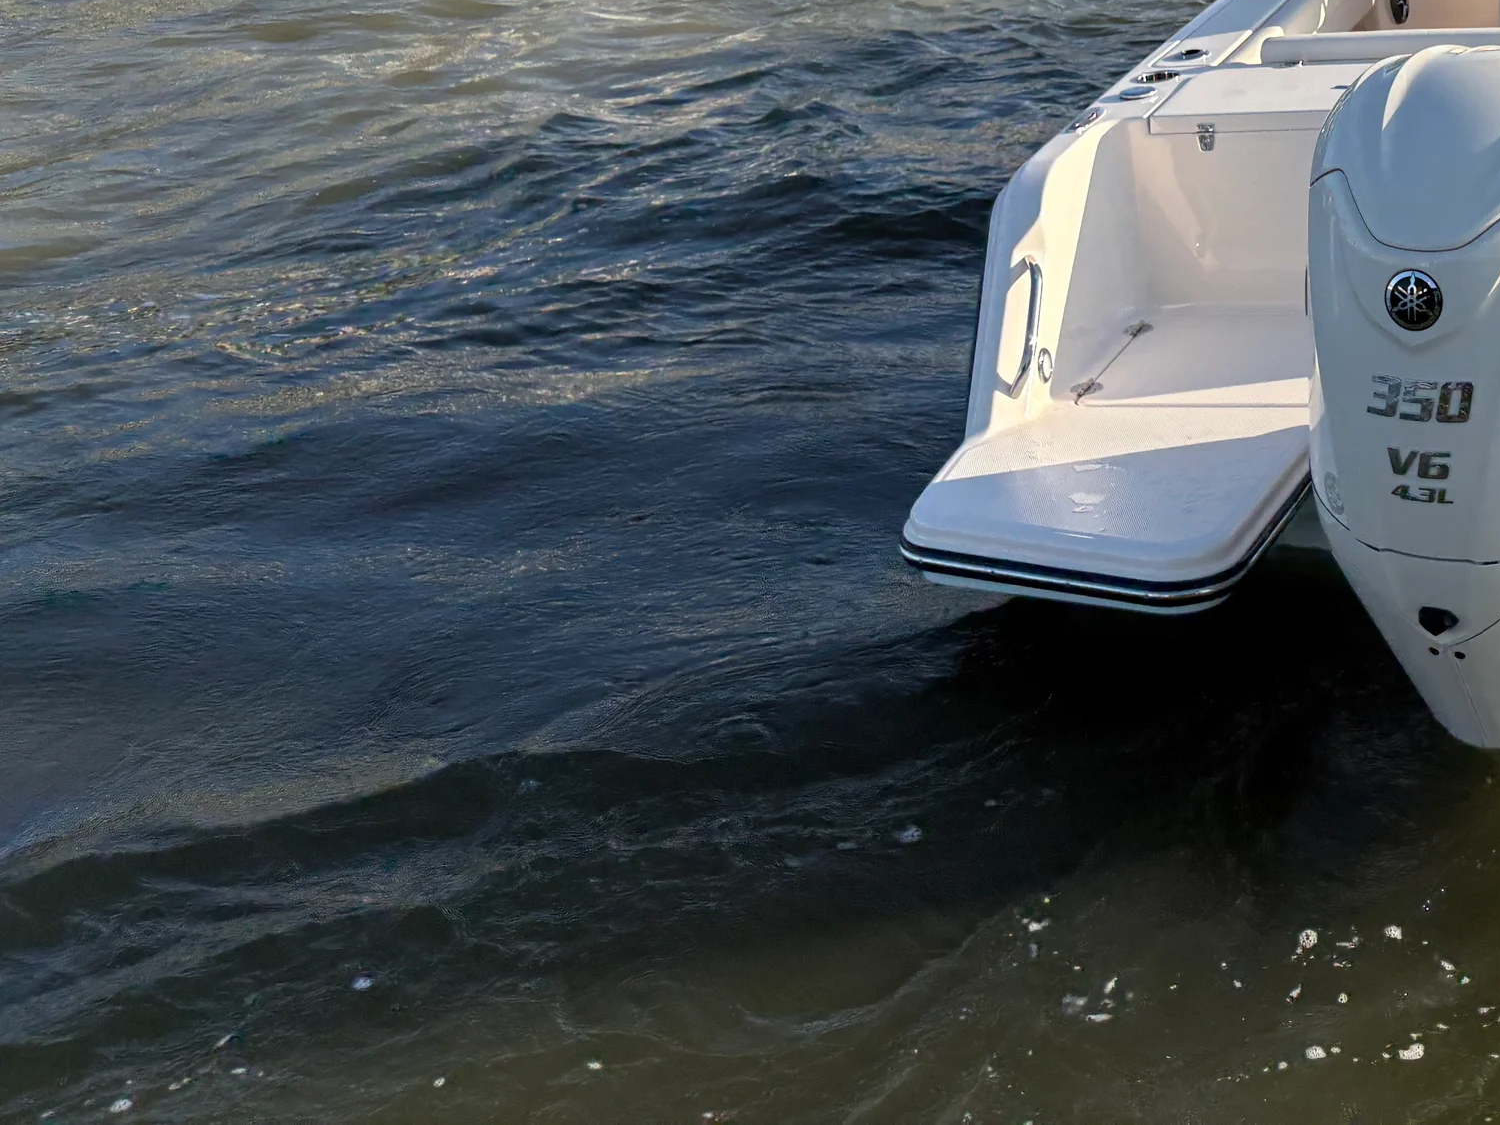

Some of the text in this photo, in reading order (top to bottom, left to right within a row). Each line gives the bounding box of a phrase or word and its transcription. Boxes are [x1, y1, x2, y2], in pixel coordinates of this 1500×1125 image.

[1366, 374, 1474, 423] 350
[1387, 445, 1451, 480] V6
[1391, 483, 1454, 504] 4.3L
